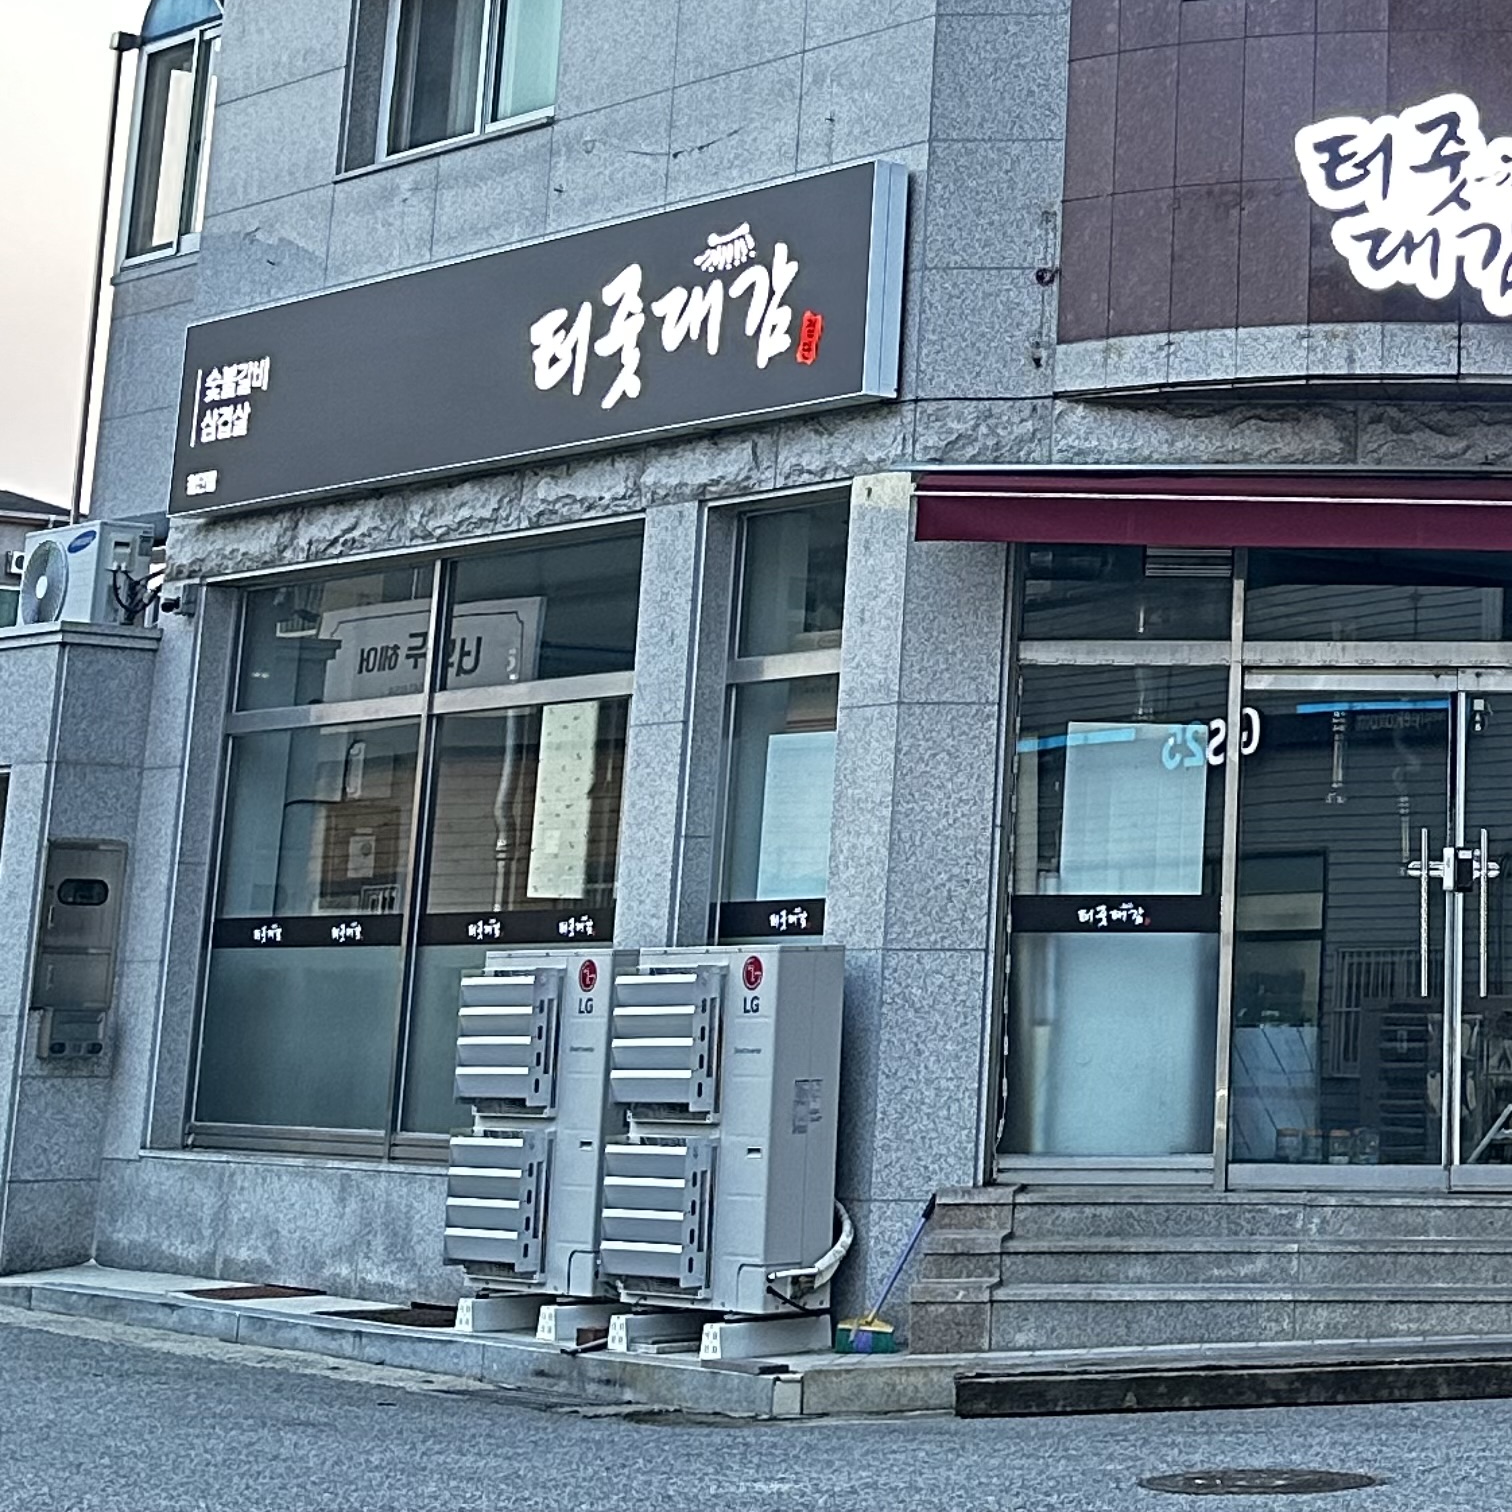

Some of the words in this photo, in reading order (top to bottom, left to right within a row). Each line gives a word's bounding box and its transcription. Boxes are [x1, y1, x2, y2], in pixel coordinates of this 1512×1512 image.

[203, 356, 270, 403] 숯불갈비
[201, 401, 251, 443] 삼겹살
[577, 997, 594, 1015] LG
[743, 995, 760, 1014] LG
